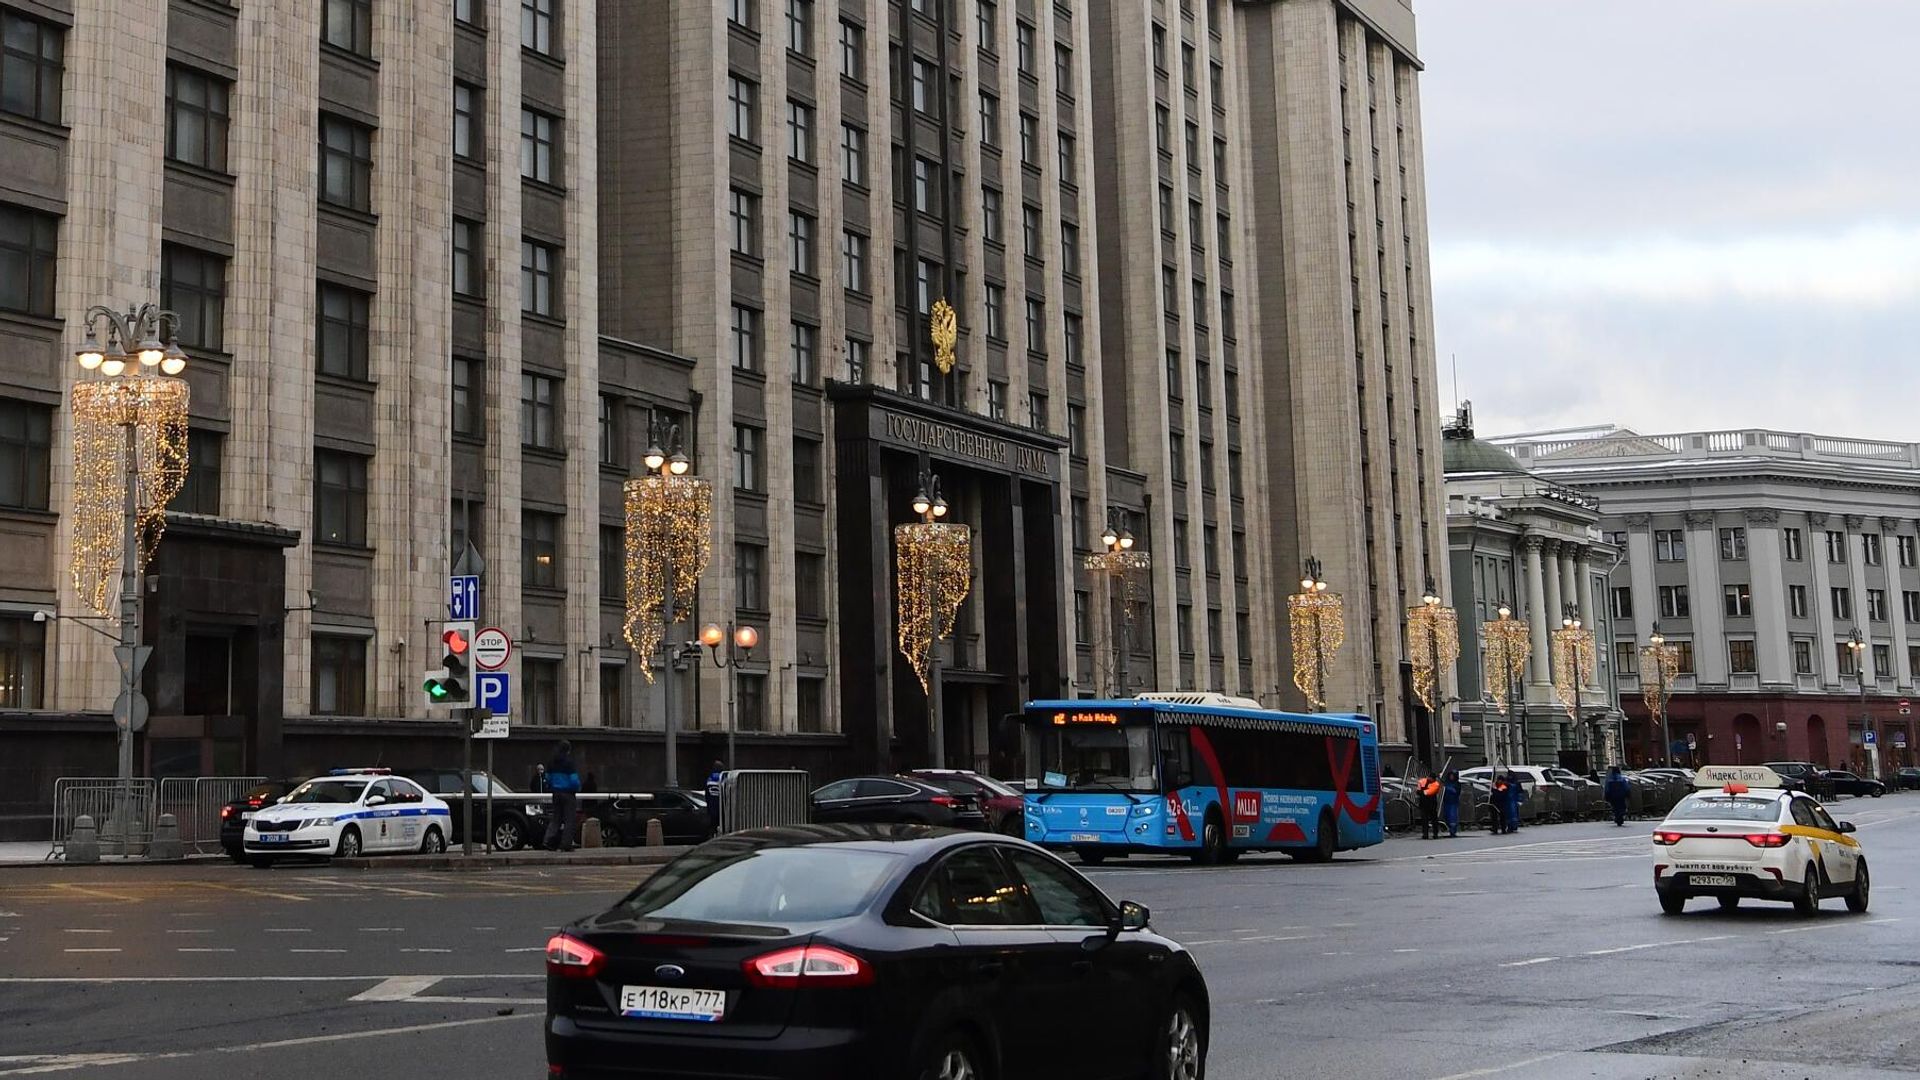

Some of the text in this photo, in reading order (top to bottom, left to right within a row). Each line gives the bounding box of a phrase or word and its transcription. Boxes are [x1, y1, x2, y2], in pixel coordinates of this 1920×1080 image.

[885, 412, 1048, 475] ГОСУДАРСТВЕННАЯ ДУМА
[480, 638, 503, 646] STOP
[481, 677, 502, 709] P
[1865, 732, 1874, 742] P
[1705, 769, 1765, 782] Яндекс Такси
[1236, 798, 1258, 816] МЦД
[626, 989, 720, 1010] Е118КР 777
